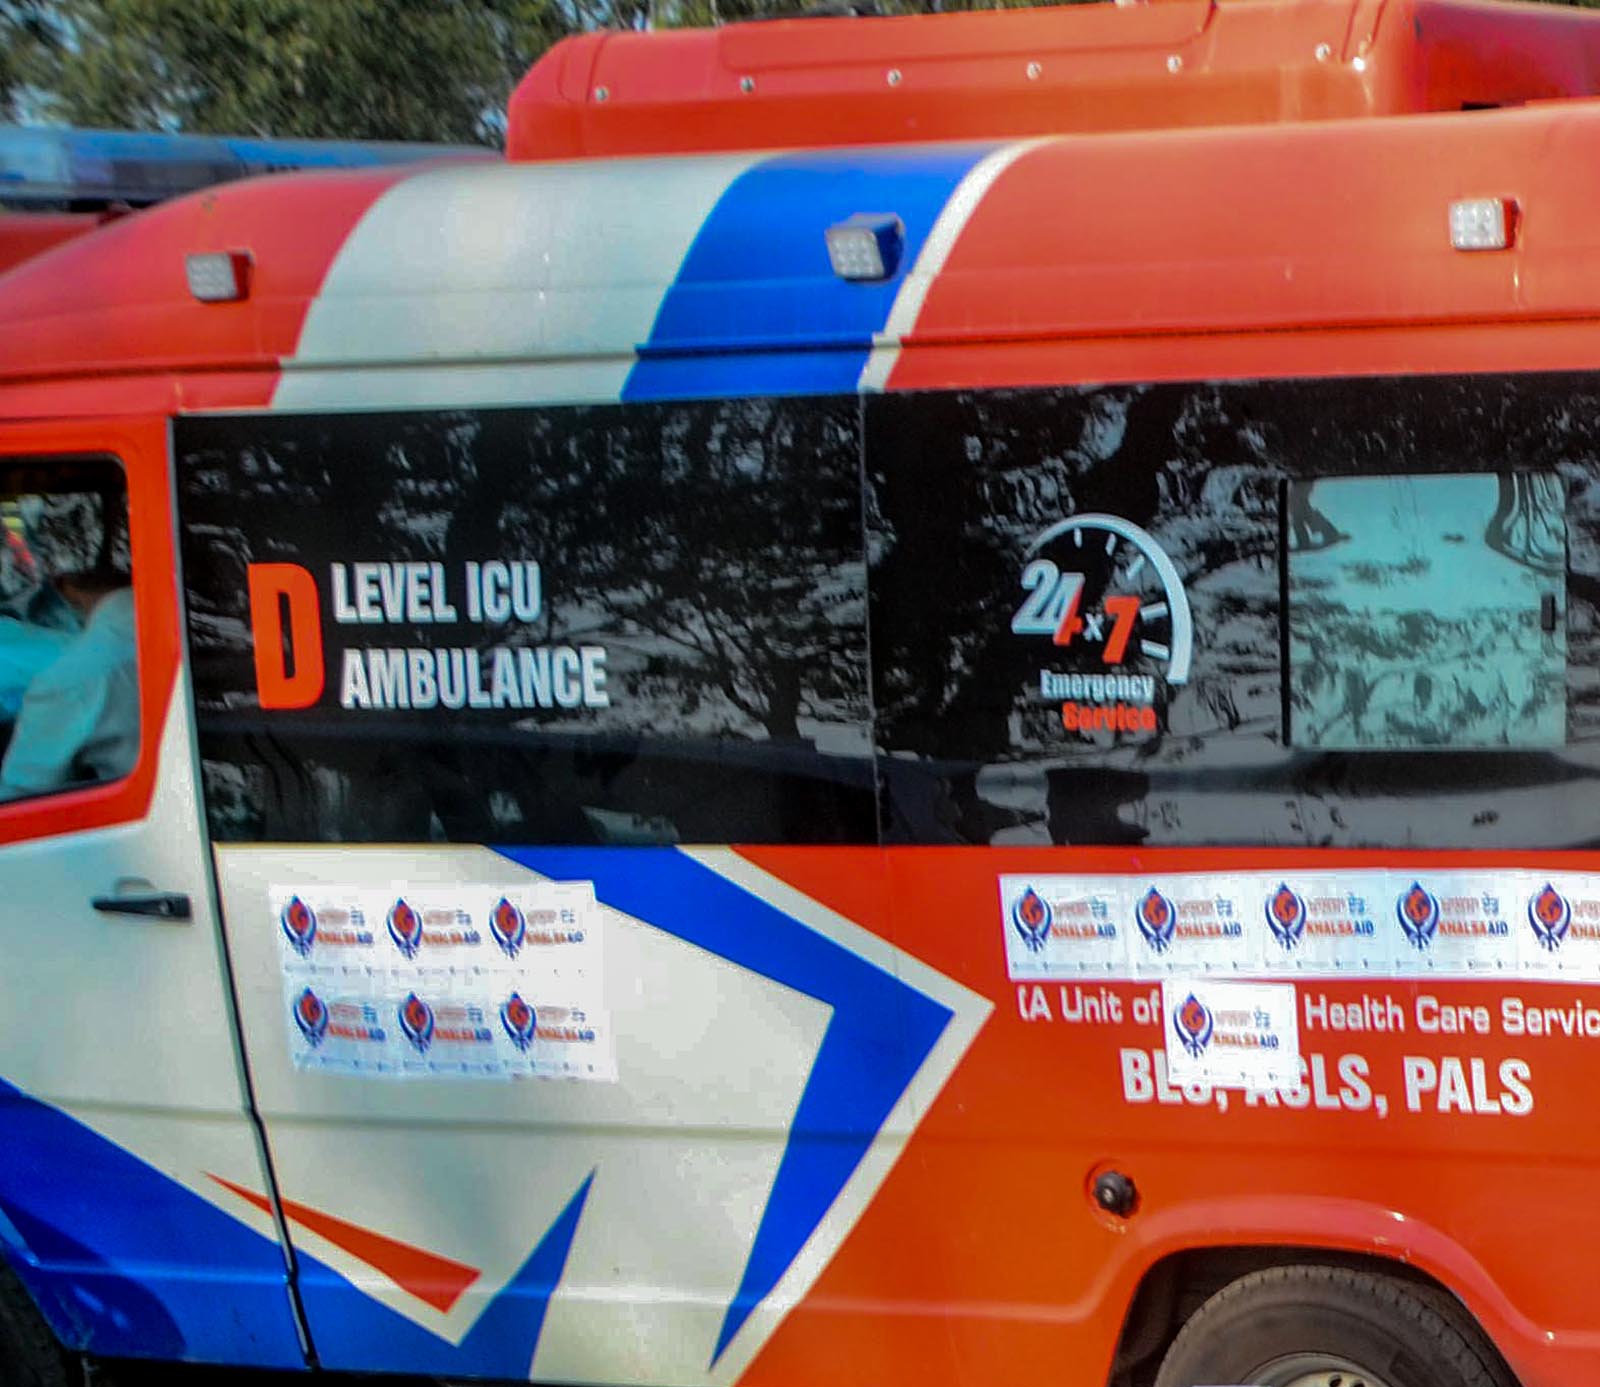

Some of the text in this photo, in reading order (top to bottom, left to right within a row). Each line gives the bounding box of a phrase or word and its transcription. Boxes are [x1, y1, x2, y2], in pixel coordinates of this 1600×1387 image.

[330, 561, 542, 625] LEVEL ICU
[247, 562, 326, 711] D
[340, 646, 610, 711] AMBULANCE
[1040, 669, 1155, 703] Emergency
[1062, 702, 1158, 734] Service
[1016, 984, 1053, 1022] (A
[1060, 986, 1125, 1025] Unit
[1131, 988, 1161, 1024] of
[1304, 992, 1404, 1034] Health
[1416, 994, 1492, 1036] Care
[1403, 1055, 1535, 1116] PALS
